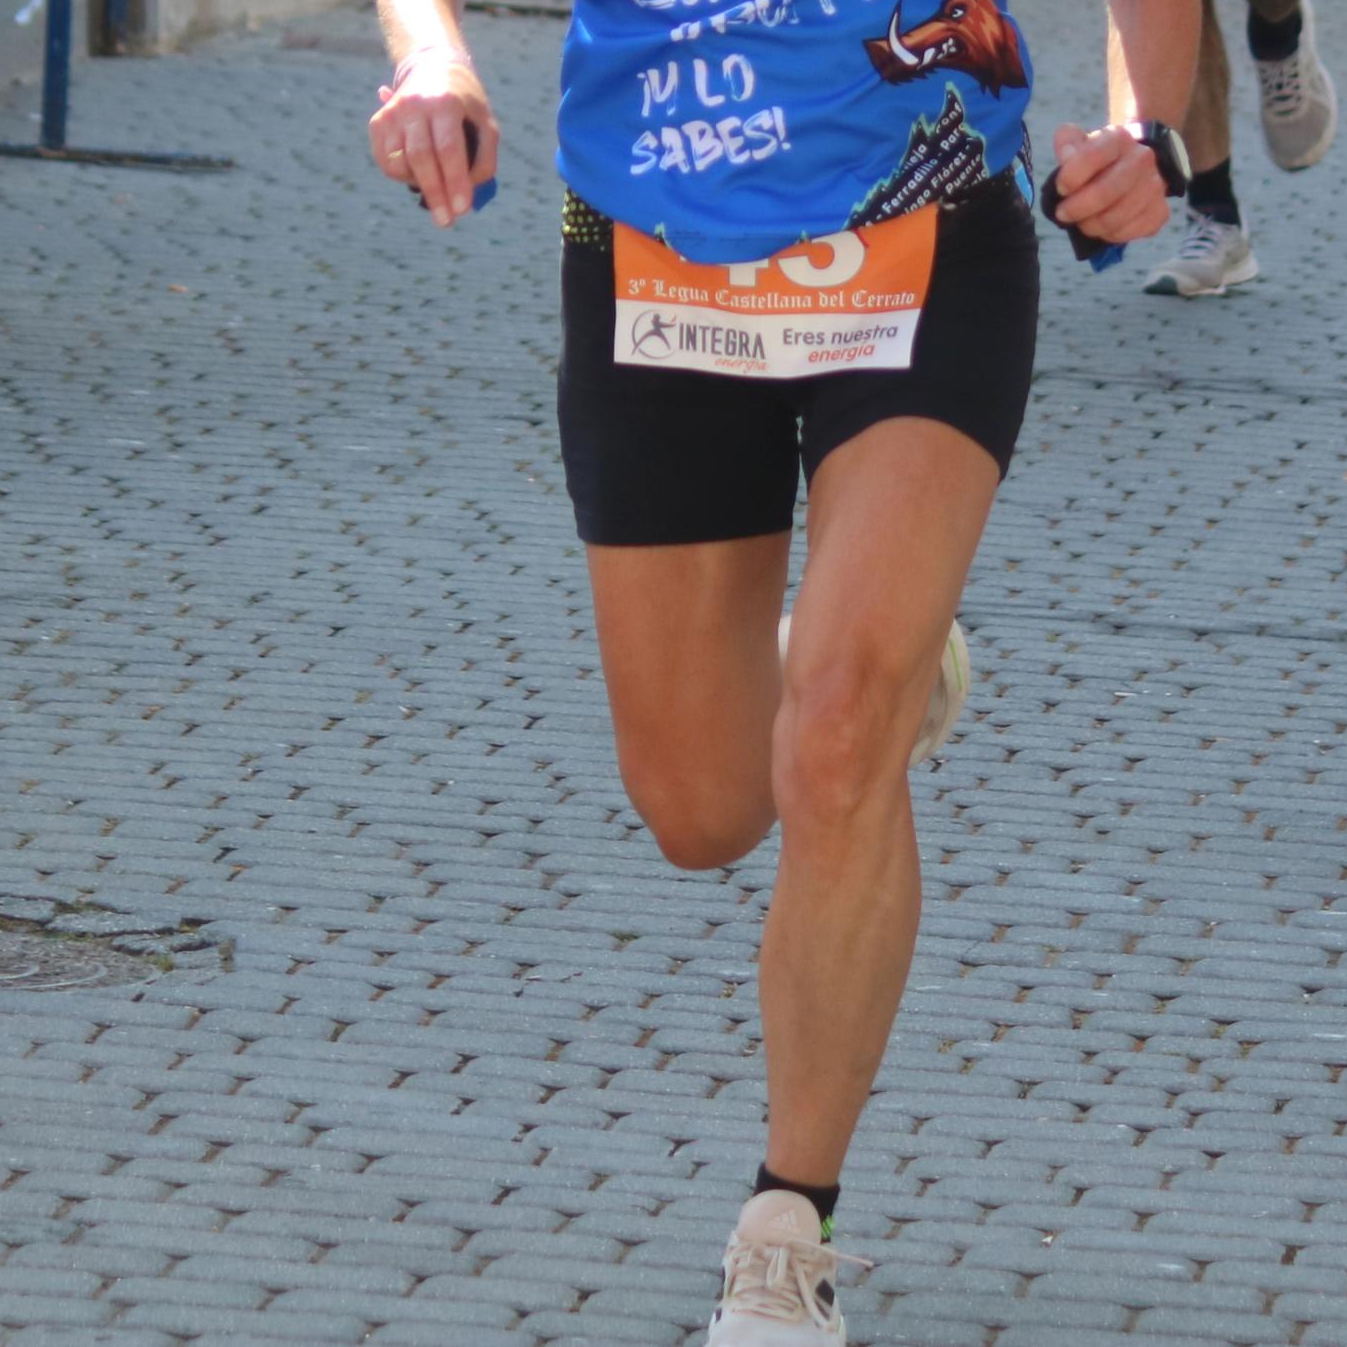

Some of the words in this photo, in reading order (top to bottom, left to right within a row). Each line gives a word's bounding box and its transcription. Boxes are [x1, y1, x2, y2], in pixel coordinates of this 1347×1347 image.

[693, 53, 756, 107] LO
[629, 105, 792, 176] SABES!
[880, 157, 939, 216] Ferradillo
[652, 279, 710, 303] Legua
[715, 288, 813, 310] Castellana
[818, 290, 845, 308] del
[851, 289, 915, 309] Cerrato
[679, 322, 767, 360] INTEGRA
[782, 327, 826, 346] Eres
[830, 323, 899, 345] nuestra
